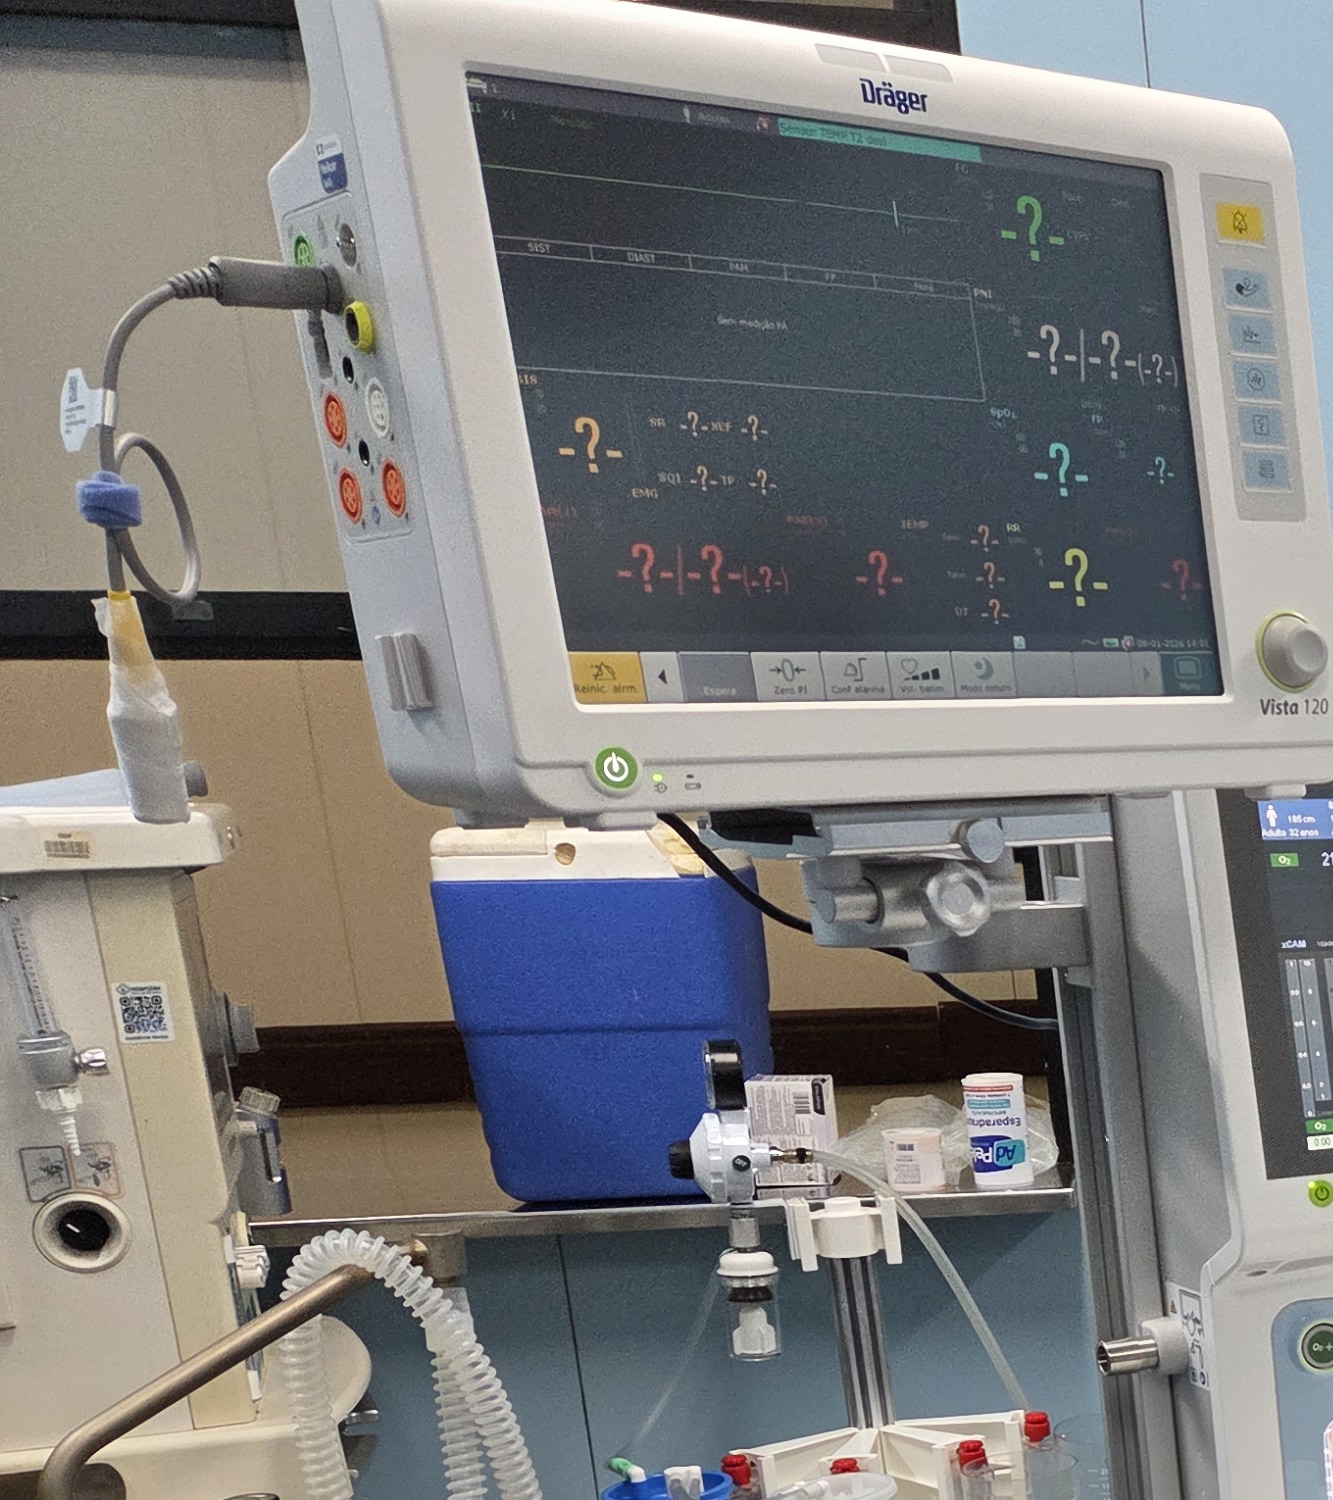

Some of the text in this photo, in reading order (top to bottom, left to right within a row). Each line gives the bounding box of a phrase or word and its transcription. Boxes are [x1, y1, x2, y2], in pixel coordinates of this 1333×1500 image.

[859, 78, 928, 114] Dräger
[527, 242, 551, 254] SIST
[627, 252, 656, 264] DIAST
[631, 487, 659, 499] EMG
[1259, 697, 1330, 716] Vista 120
[1313, 1137, 1331, 1146] 0.00
[995, 1144, 1016, 1163] Ad
